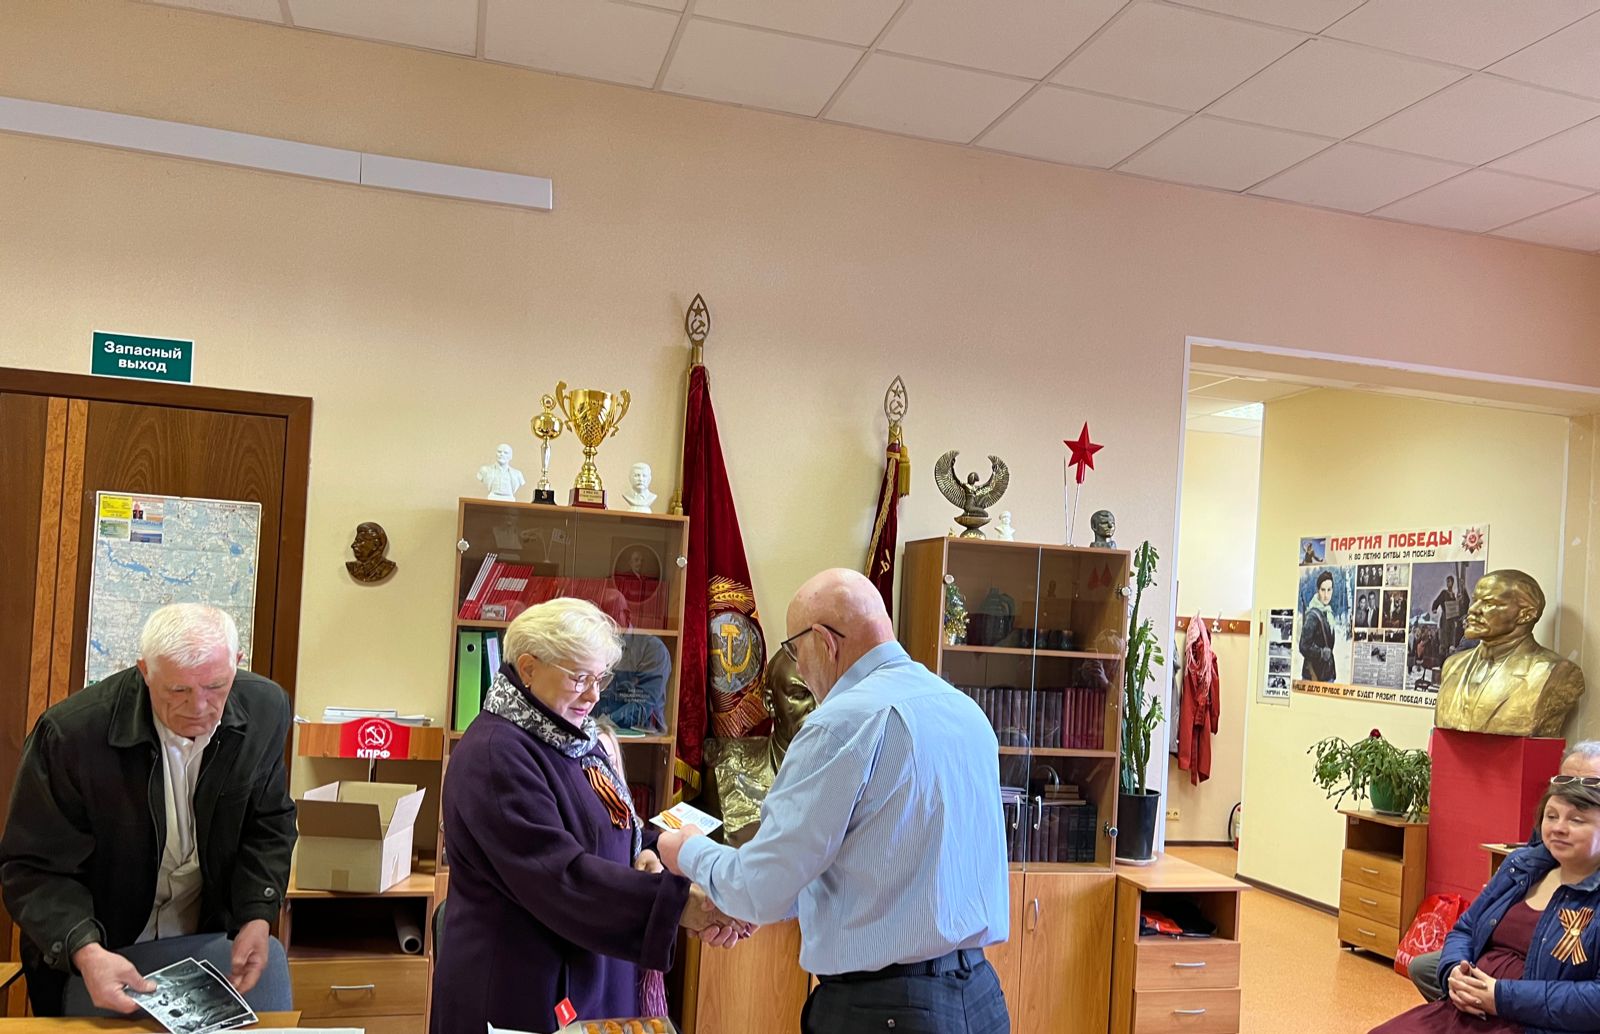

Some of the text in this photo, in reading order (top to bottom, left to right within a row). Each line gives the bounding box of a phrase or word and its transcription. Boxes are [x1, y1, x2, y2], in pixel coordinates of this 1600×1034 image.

[104, 340, 182, 359] Запасный
[118, 359, 167, 373] выход
[1330, 530, 1452, 551] ПАРТИЯ ПОБЕДЫ
[1362, 552, 1381, 560] ЛЕТИЮ
[1383, 551, 1401, 559] БИТВЫ
[1412, 549, 1436, 558] МОСКВУ
[1307, 684, 1321, 693] ДЕЛО
[1342, 688, 1356, 697] ВРАГ
[1357, 690, 1374, 699] БУДЕТ
[1399, 694, 1423, 704] ПОБЕДА
[356, 748, 391, 759] КПРФ
